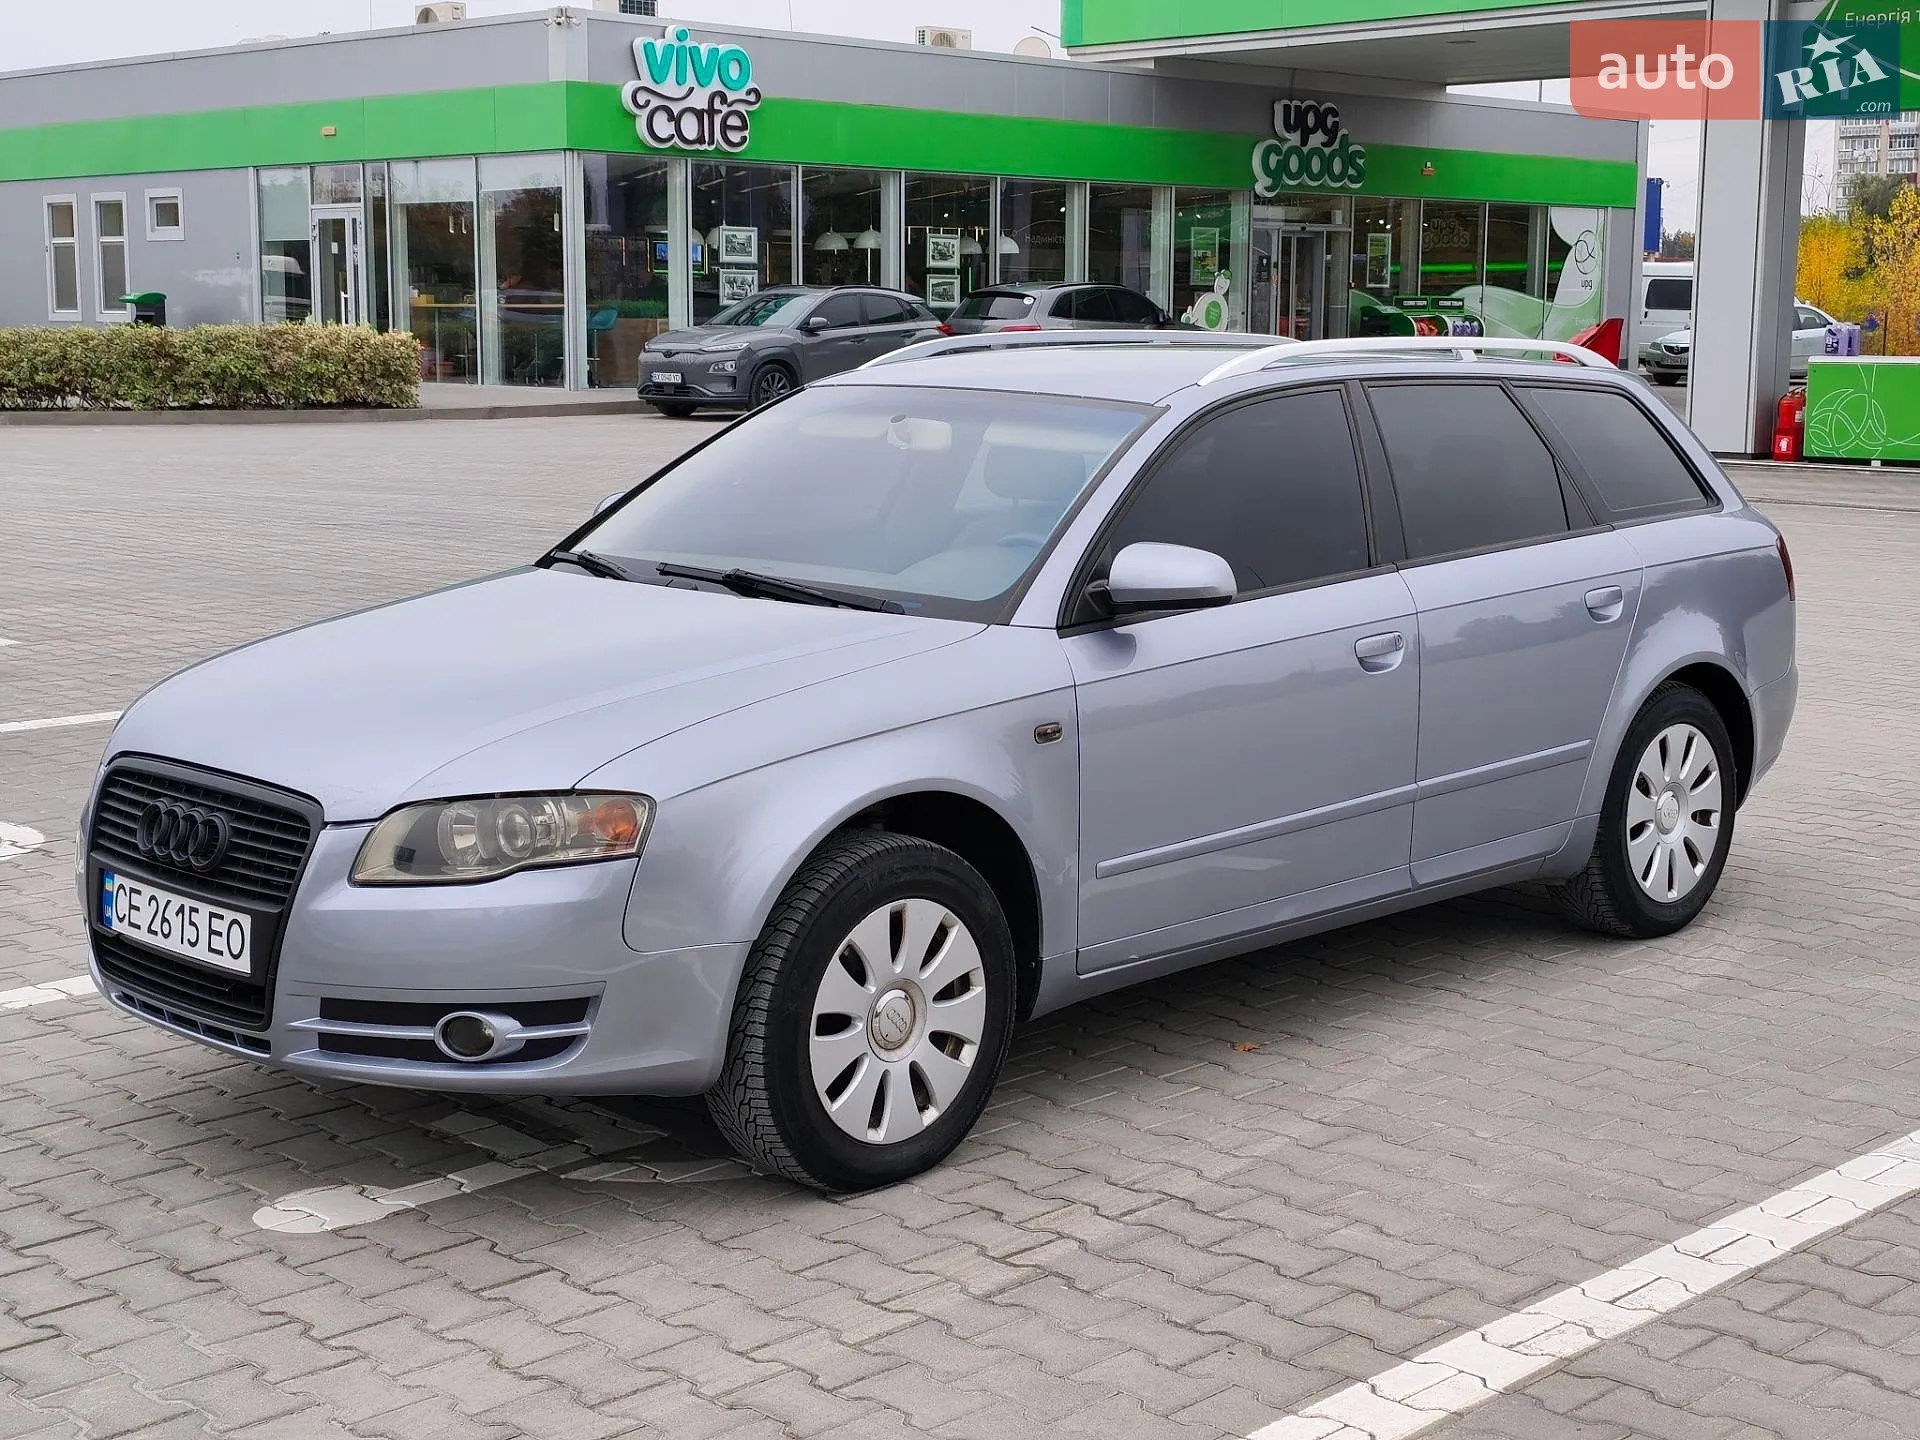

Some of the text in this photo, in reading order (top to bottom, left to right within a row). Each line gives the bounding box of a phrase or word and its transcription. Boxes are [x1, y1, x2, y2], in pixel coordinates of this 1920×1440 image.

[1845, 8, 1911, 29] Енергія
[642, 27, 751, 92] vivo
[1282, 101, 1340, 147] upg
[1260, 129, 1366, 194] goods
[1581, 279, 1593, 290] upg
[114, 883, 245, 960] CE 2615 EO
